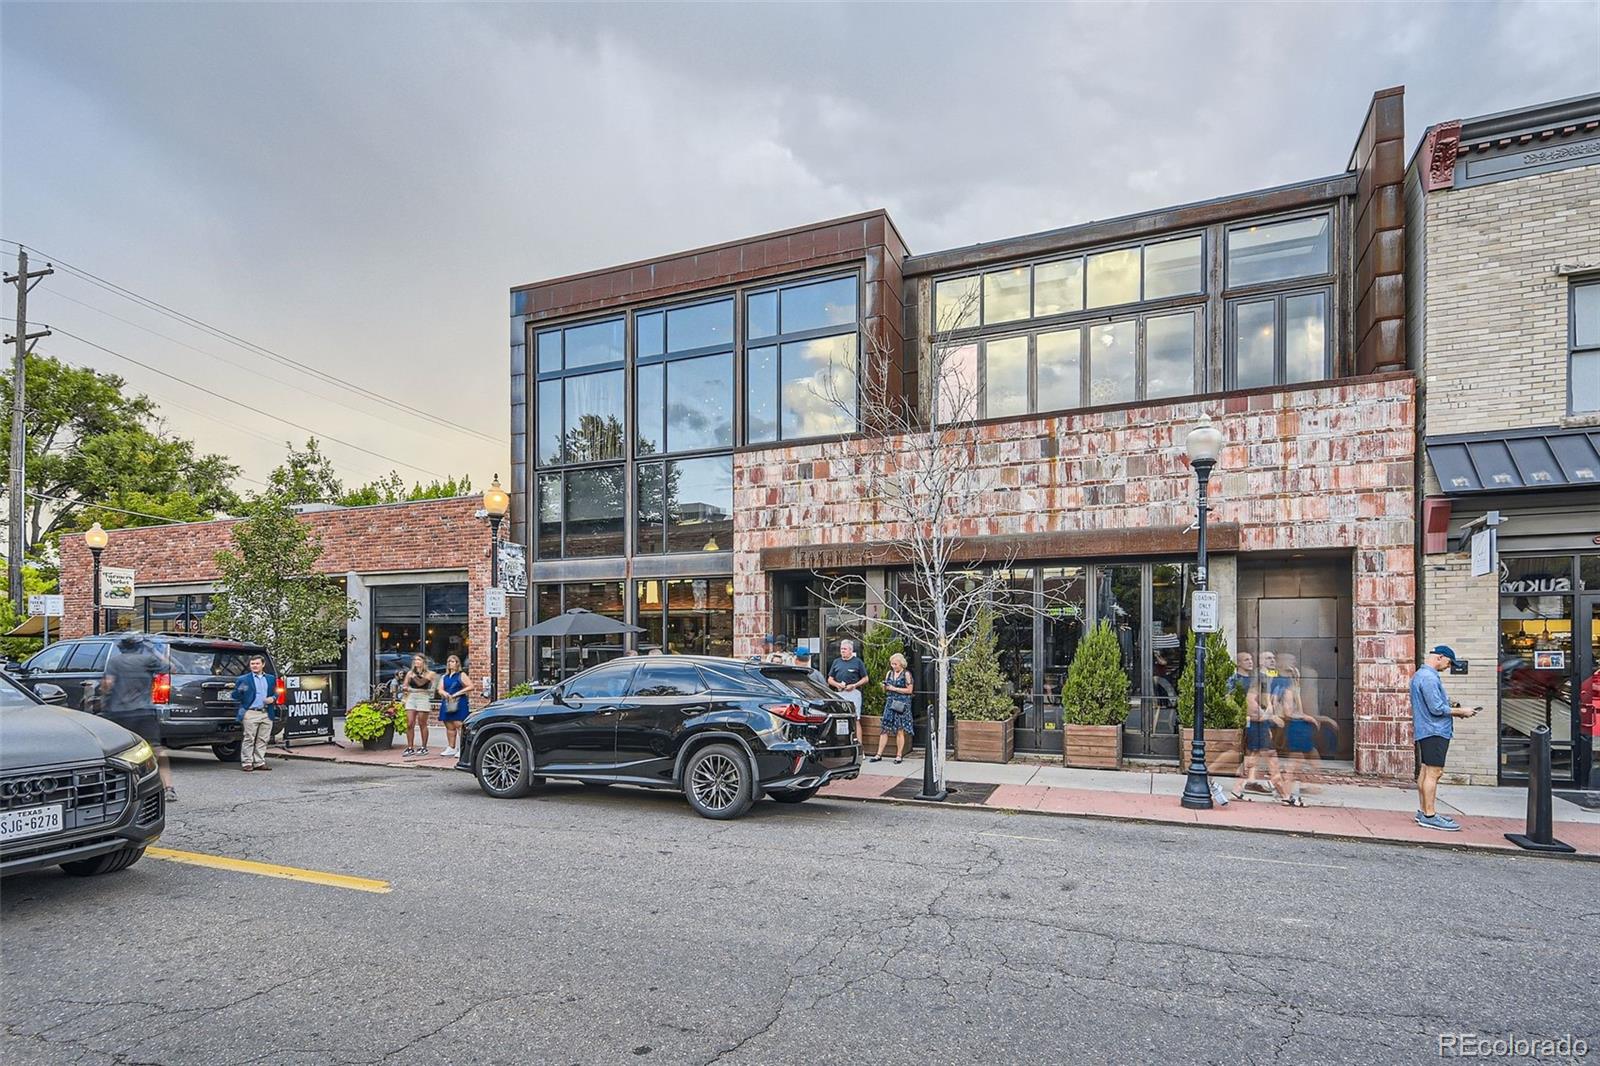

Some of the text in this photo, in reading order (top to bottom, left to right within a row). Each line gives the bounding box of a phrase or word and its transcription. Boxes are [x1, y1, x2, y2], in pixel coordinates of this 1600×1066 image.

[294, 690, 322, 703] VALET
[288, 703, 329, 717] PARKING
[17, 809, 43, 817] TEXAS
[1, 813, 58, 834] SJG-6278
